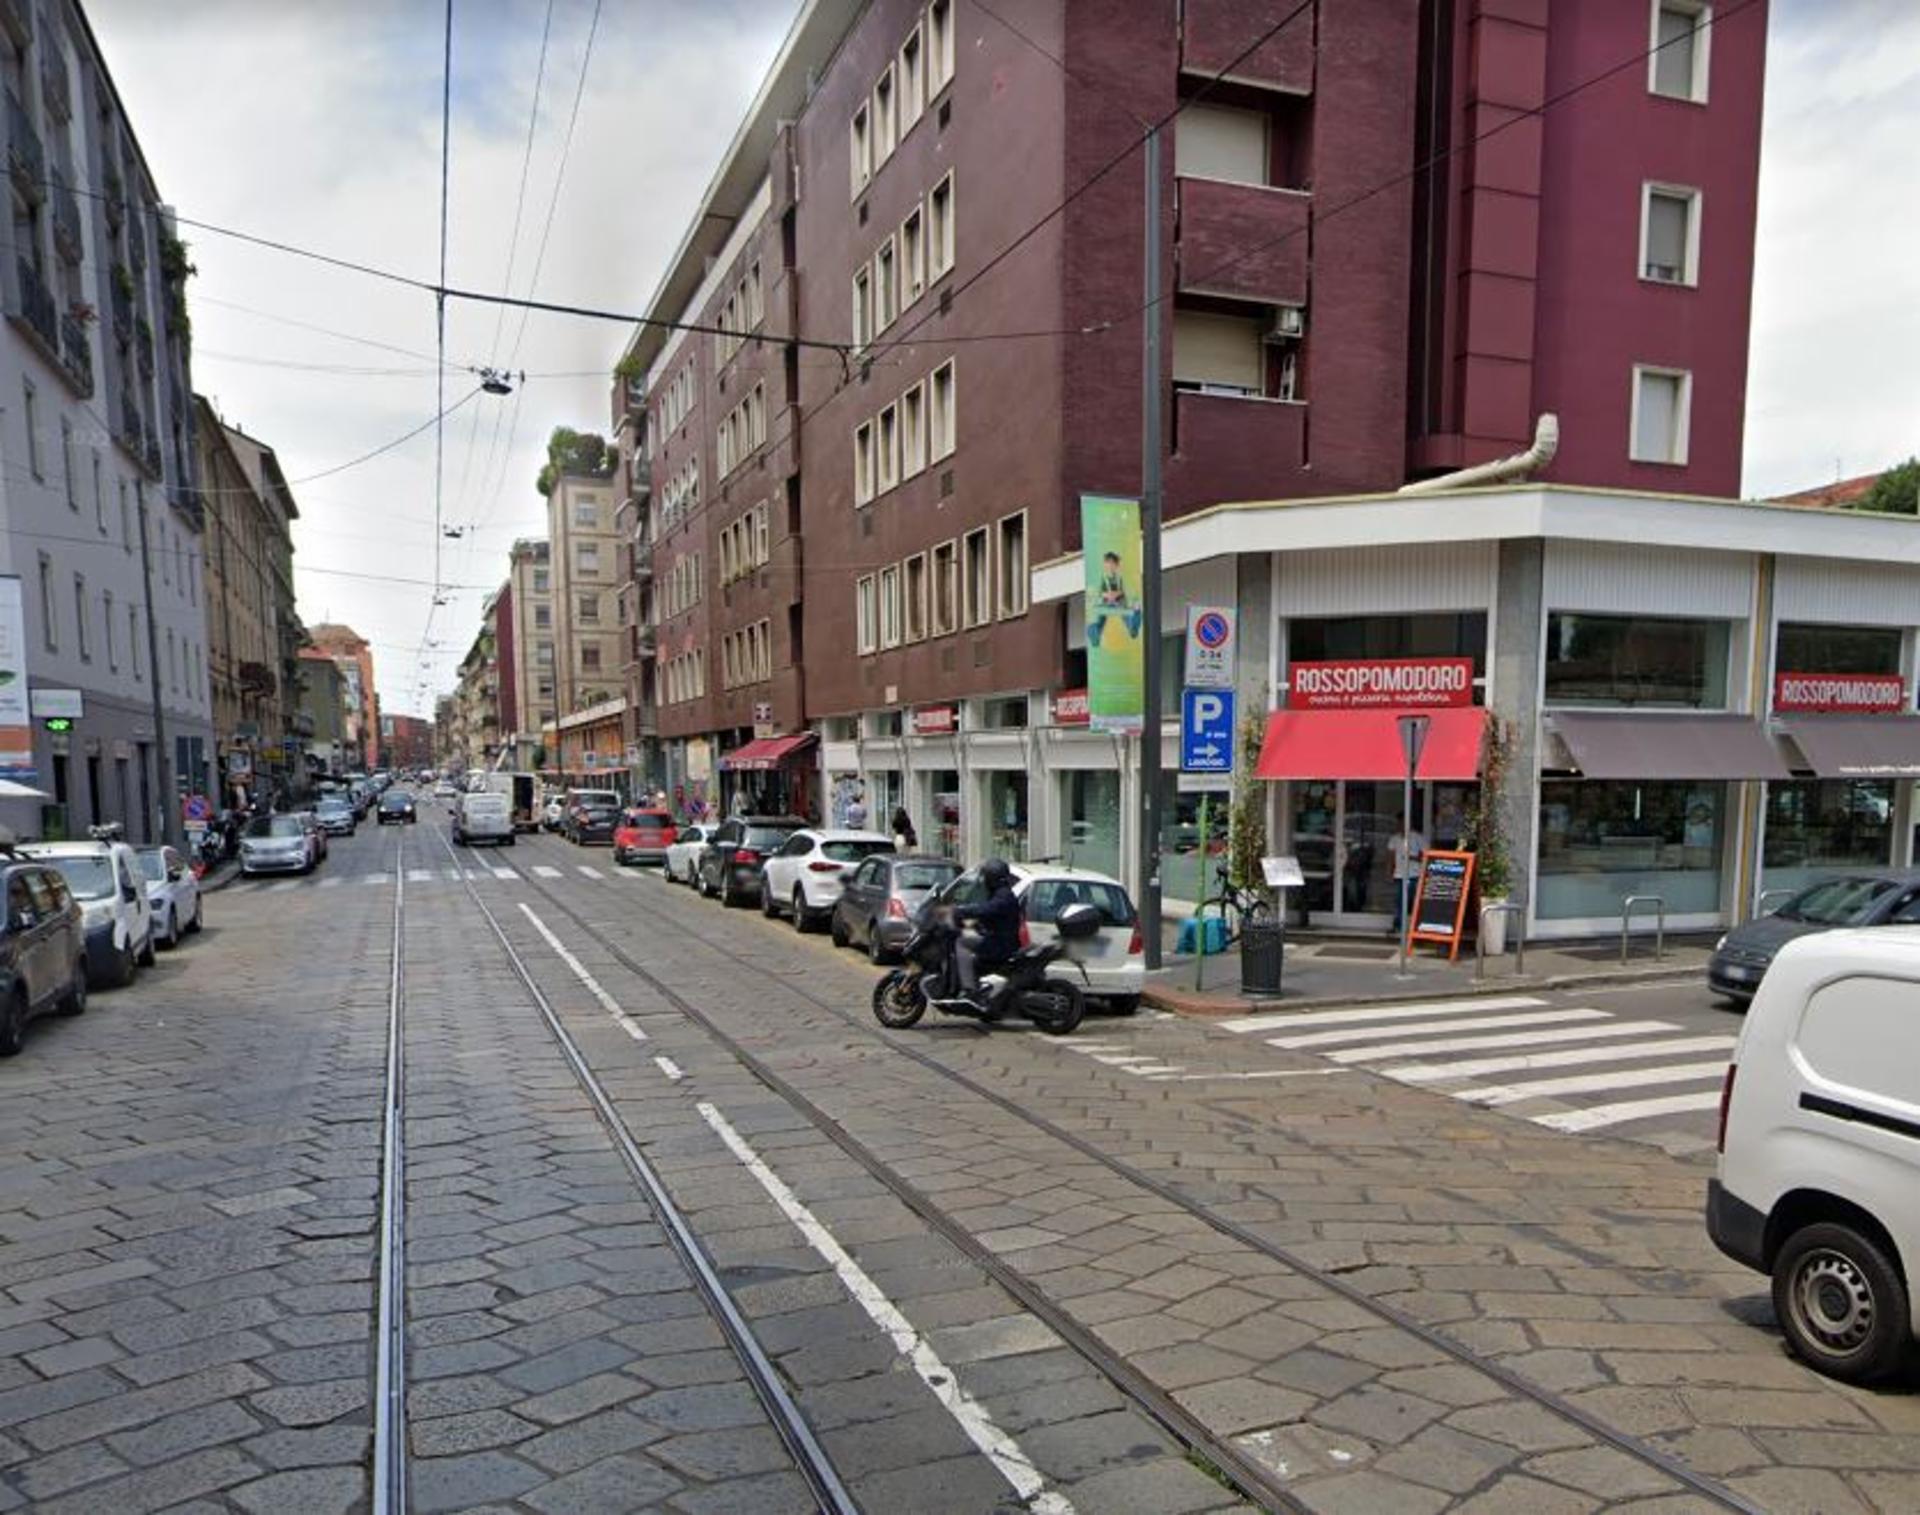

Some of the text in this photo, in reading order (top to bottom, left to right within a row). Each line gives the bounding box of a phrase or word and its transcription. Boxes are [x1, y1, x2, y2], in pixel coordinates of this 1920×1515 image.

[1296, 666, 1467, 693] ROSSOPOMODORO
[1782, 680, 1901, 705] ROSSOPOMODORO
[1193, 694, 1224, 735] P
